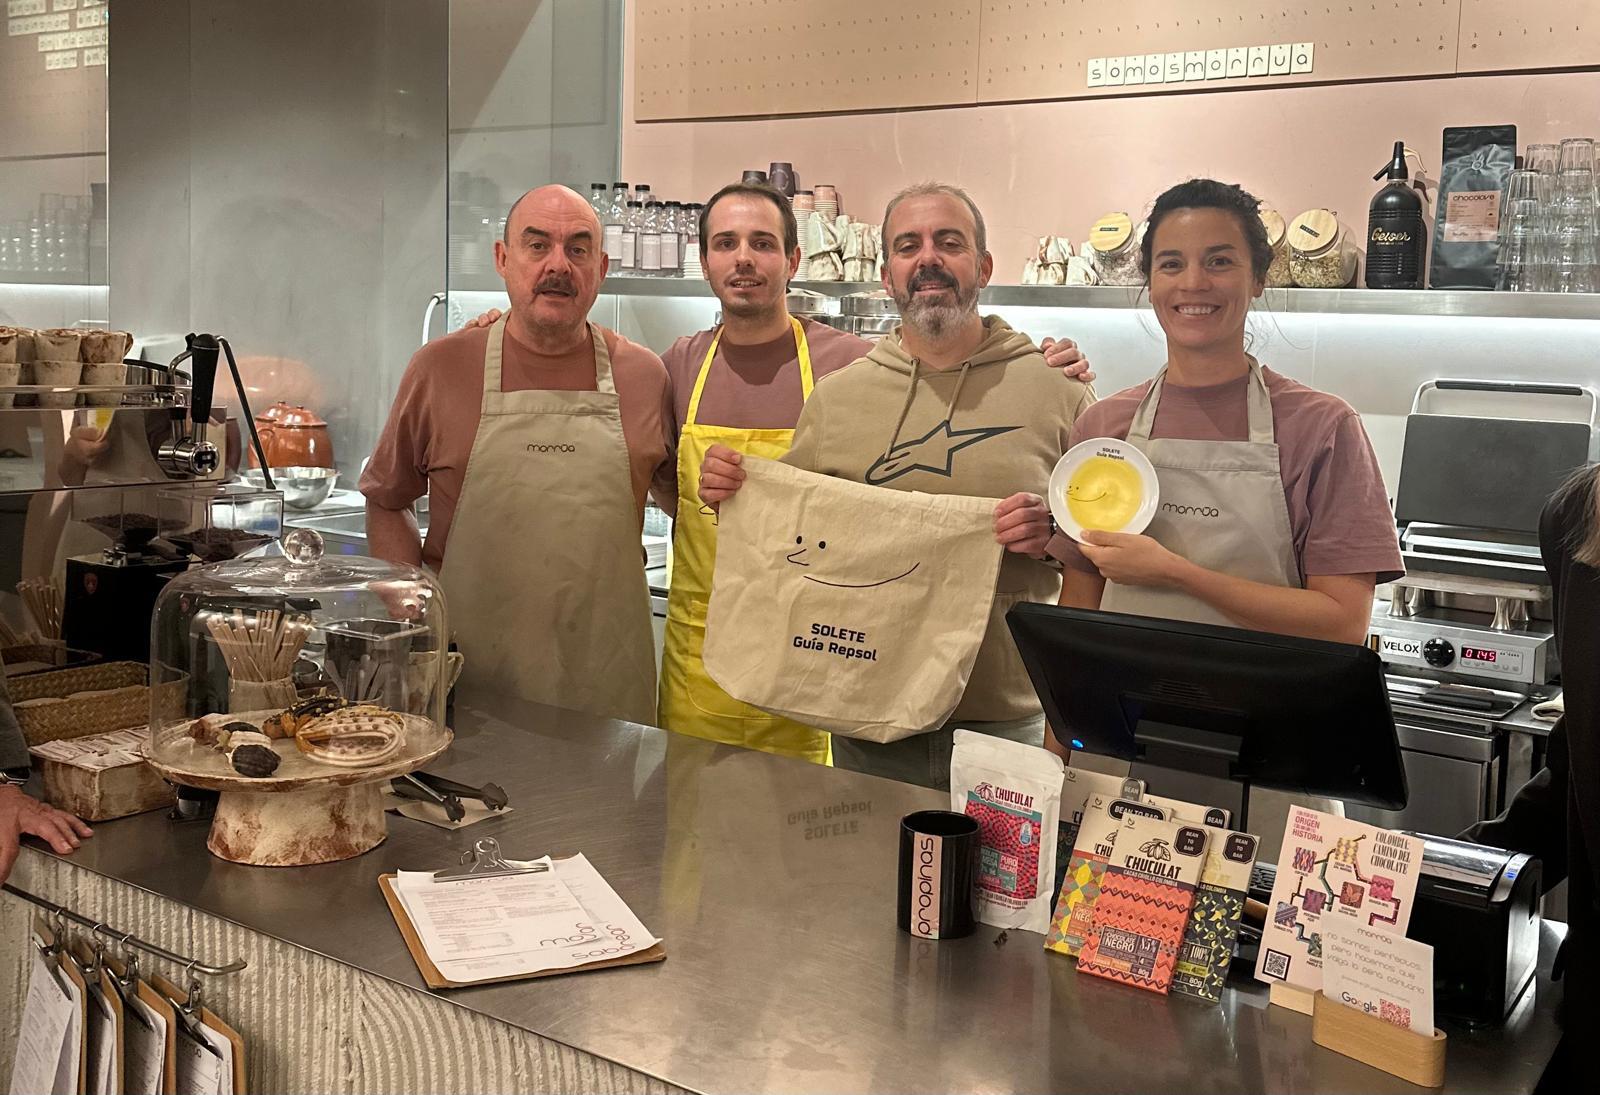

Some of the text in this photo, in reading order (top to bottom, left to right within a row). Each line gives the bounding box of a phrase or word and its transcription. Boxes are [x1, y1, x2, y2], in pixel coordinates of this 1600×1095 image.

[1091, 53, 1308, 80] somosmorrua
[811, 623, 866, 643] SOLETE
[793, 636, 877, 661] Guía Repsol
[1383, 640, 1420, 654] VELOX
[995, 786, 1034, 808] CHUCULAT
[1124, 786, 1139, 795] BEAN
[1207, 816, 1223, 825] BEAN
[1295, 815, 1320, 829] ORIGEN
[1292, 829, 1323, 843] HISTORIA
[1095, 843, 1113, 857] CHU
[1125, 855, 1182, 880] CHUCULAT
[1370, 854, 1409, 875] CHOCOLATE
[918, 837, 934, 935] propinas
[1074, 911, 1090, 923] NEG
[1104, 937, 1135, 953] NEGRO
[1106, 932, 1136, 945] CHOCOLATE
[1341, 936, 1370, 953] somos
[1341, 991, 1378, 1013] Google
